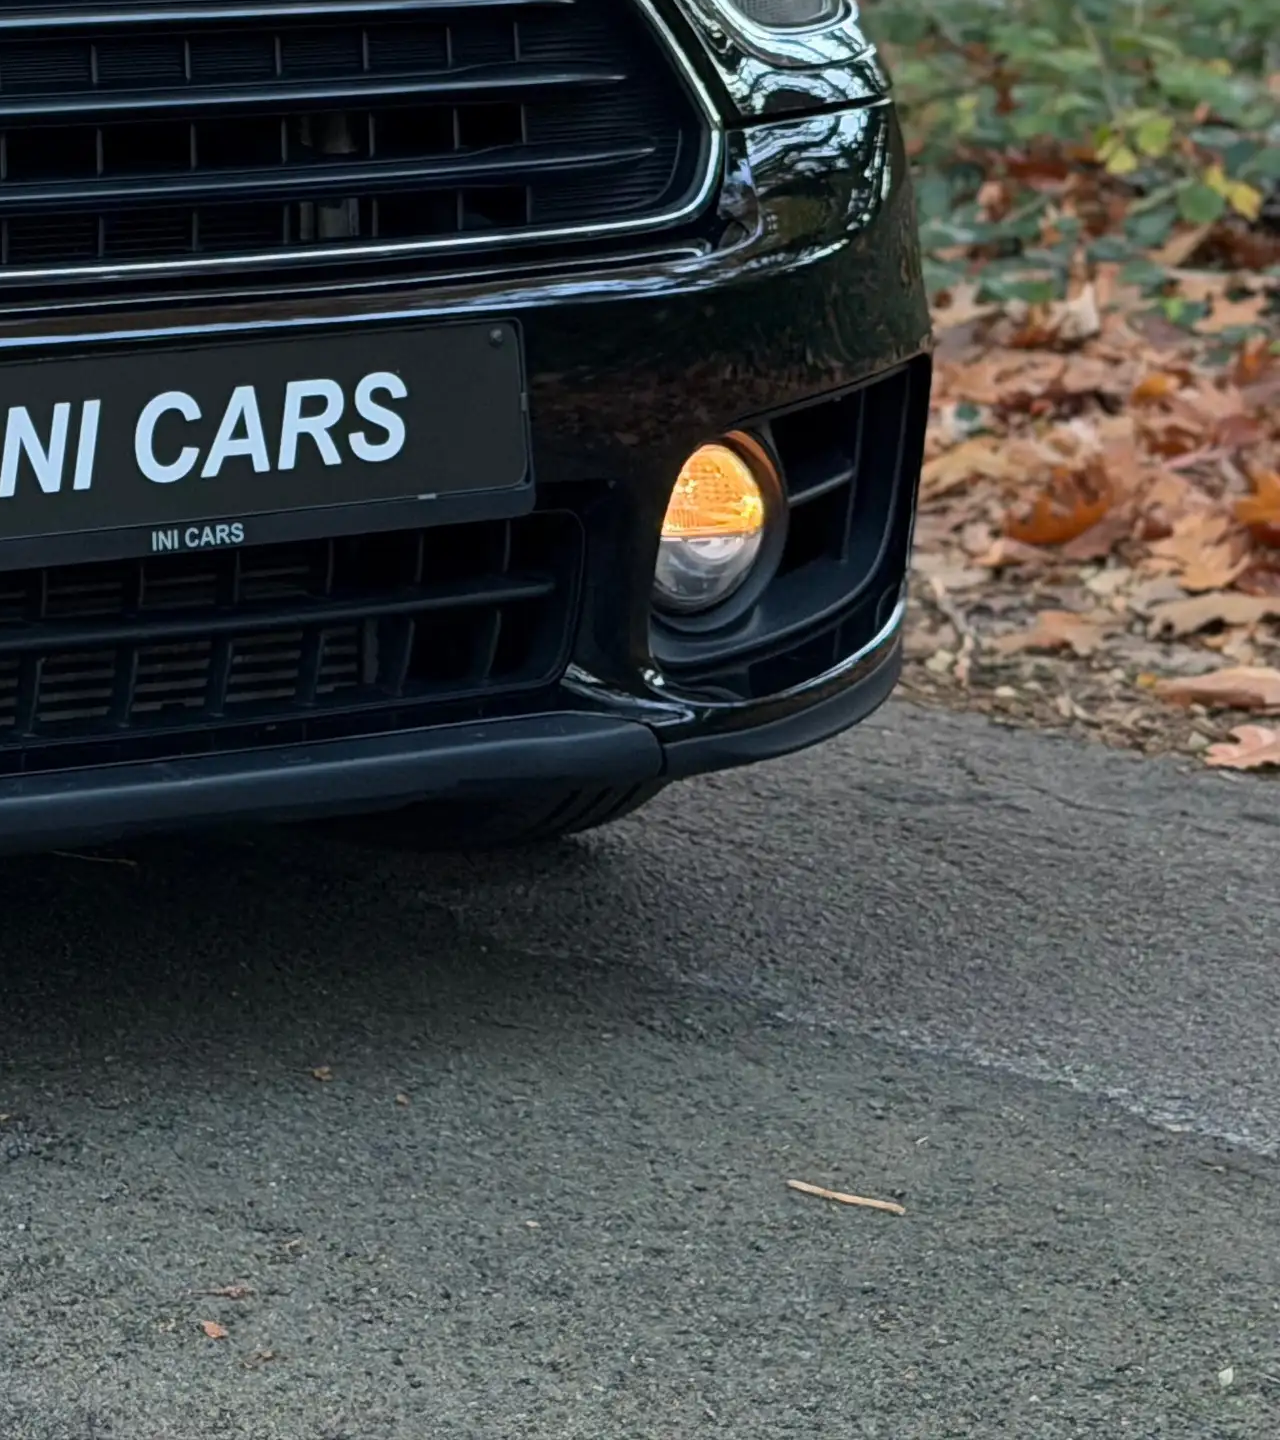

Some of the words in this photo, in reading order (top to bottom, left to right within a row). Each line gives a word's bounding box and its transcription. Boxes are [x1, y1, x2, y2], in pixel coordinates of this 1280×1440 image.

[134, 371, 408, 484] CARS
[151, 529, 179, 552] INI
[184, 522, 245, 548] CARS
